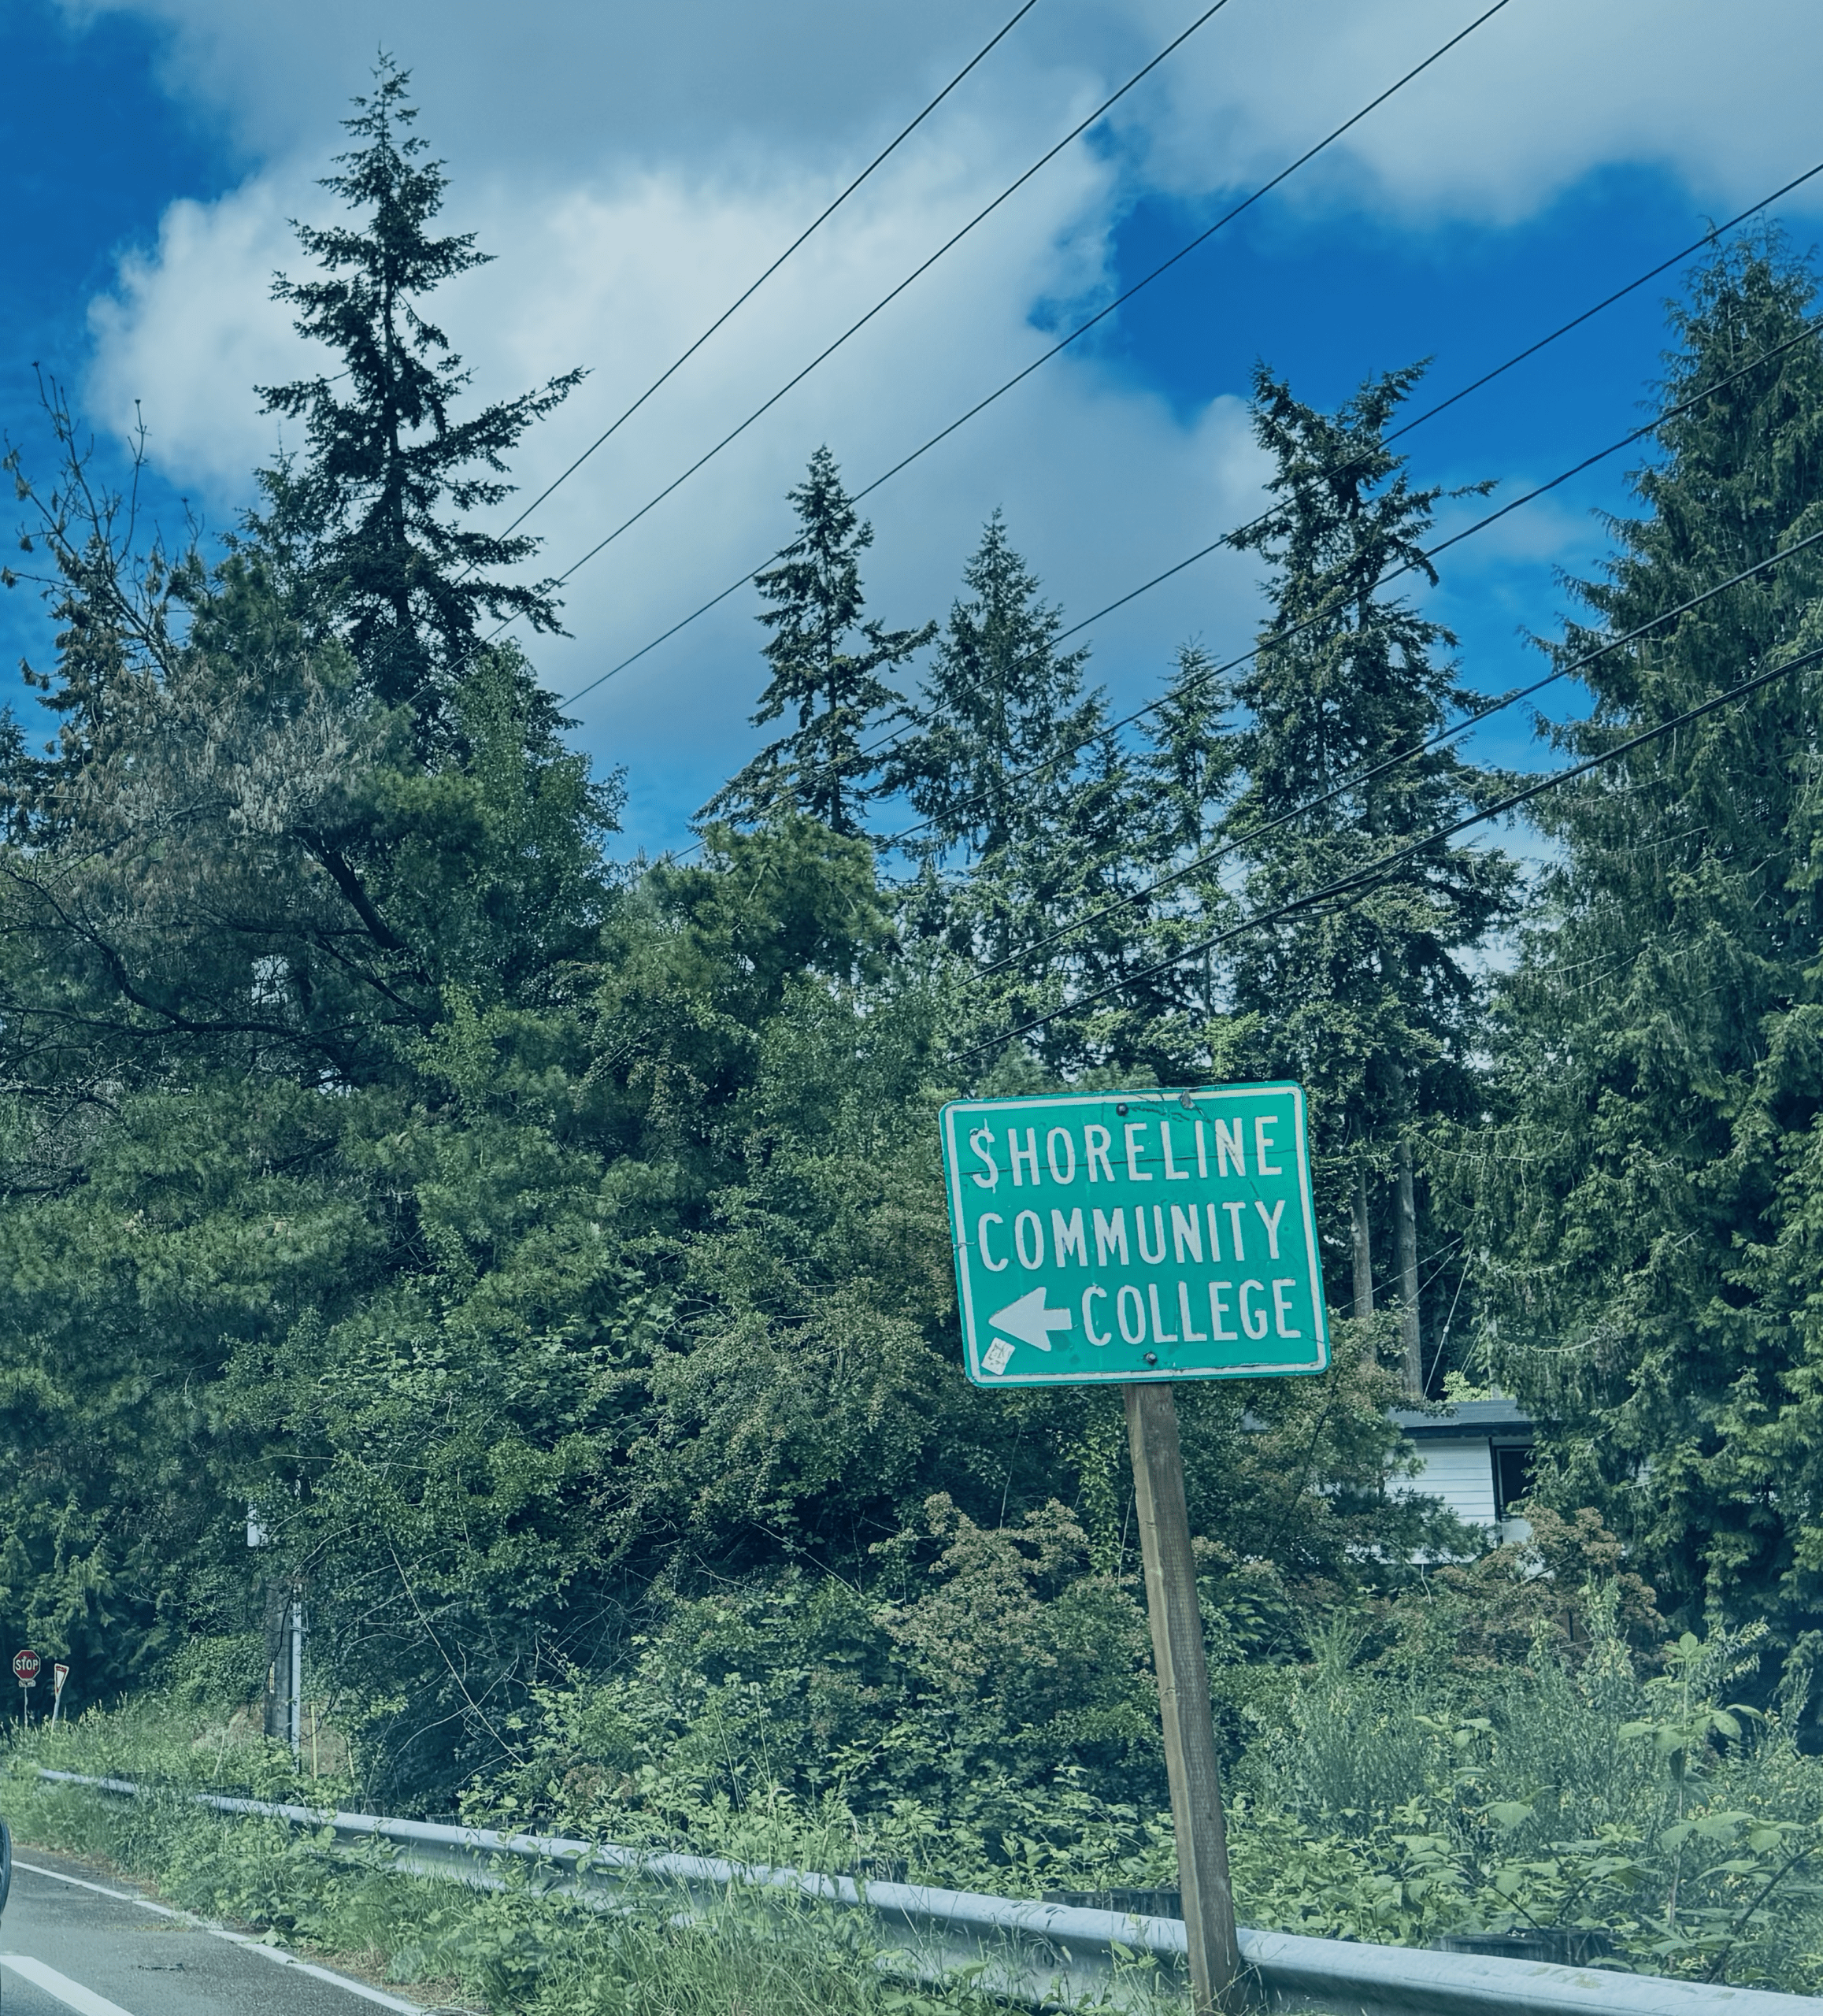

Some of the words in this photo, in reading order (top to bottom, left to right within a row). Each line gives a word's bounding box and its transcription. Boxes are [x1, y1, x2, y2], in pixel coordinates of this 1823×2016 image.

[978, 1200, 1286, 1272] COMMUNITY
[1082, 1279, 1302, 1346] COLLEGE
[15, 1658, 39, 1670] STOP
